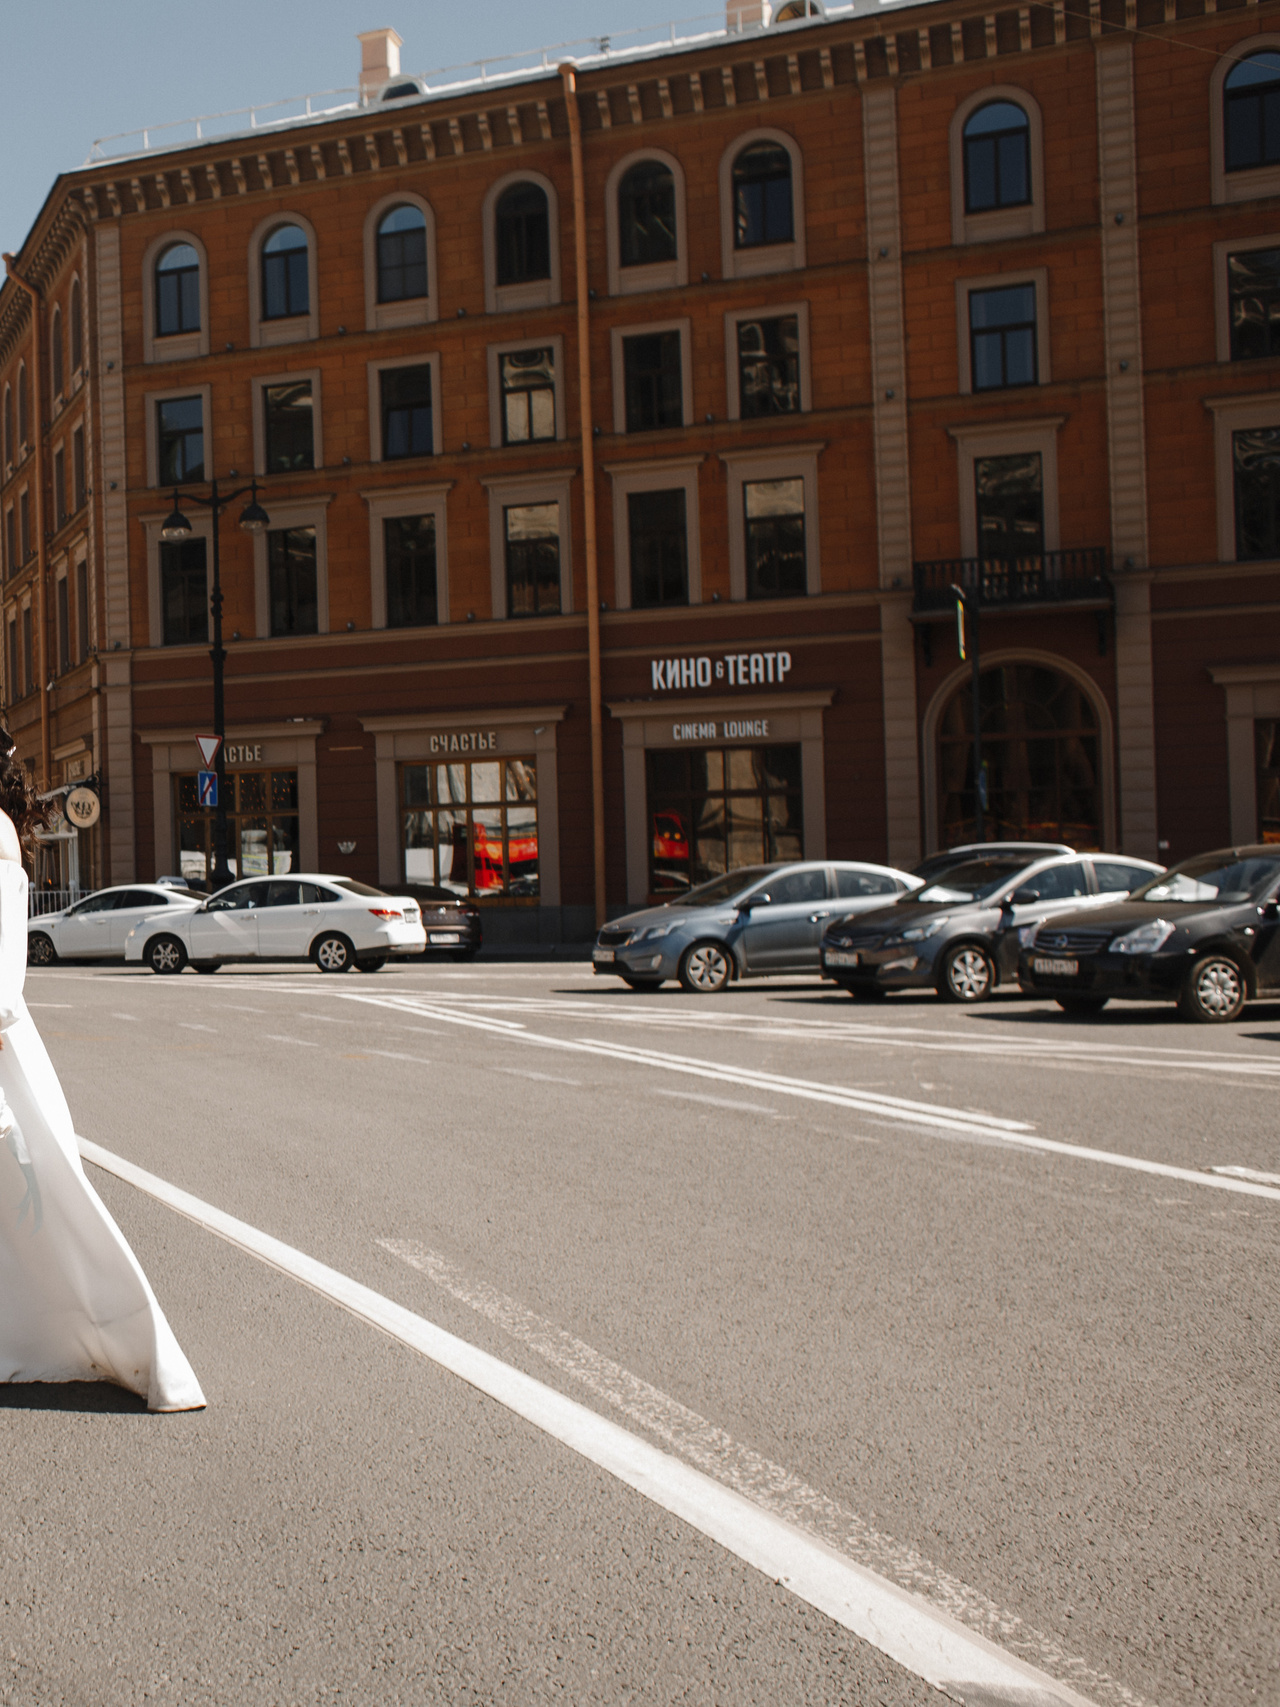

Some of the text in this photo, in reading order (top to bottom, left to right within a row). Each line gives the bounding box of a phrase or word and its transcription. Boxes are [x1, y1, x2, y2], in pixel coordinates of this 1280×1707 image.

[651, 657, 712, 690] КИНО
[724, 652, 792, 686] ТЕАТР
[673, 720, 769, 740] CINEMA LOUNGE
[430, 732, 497, 753] СЧАСТЬЕ
